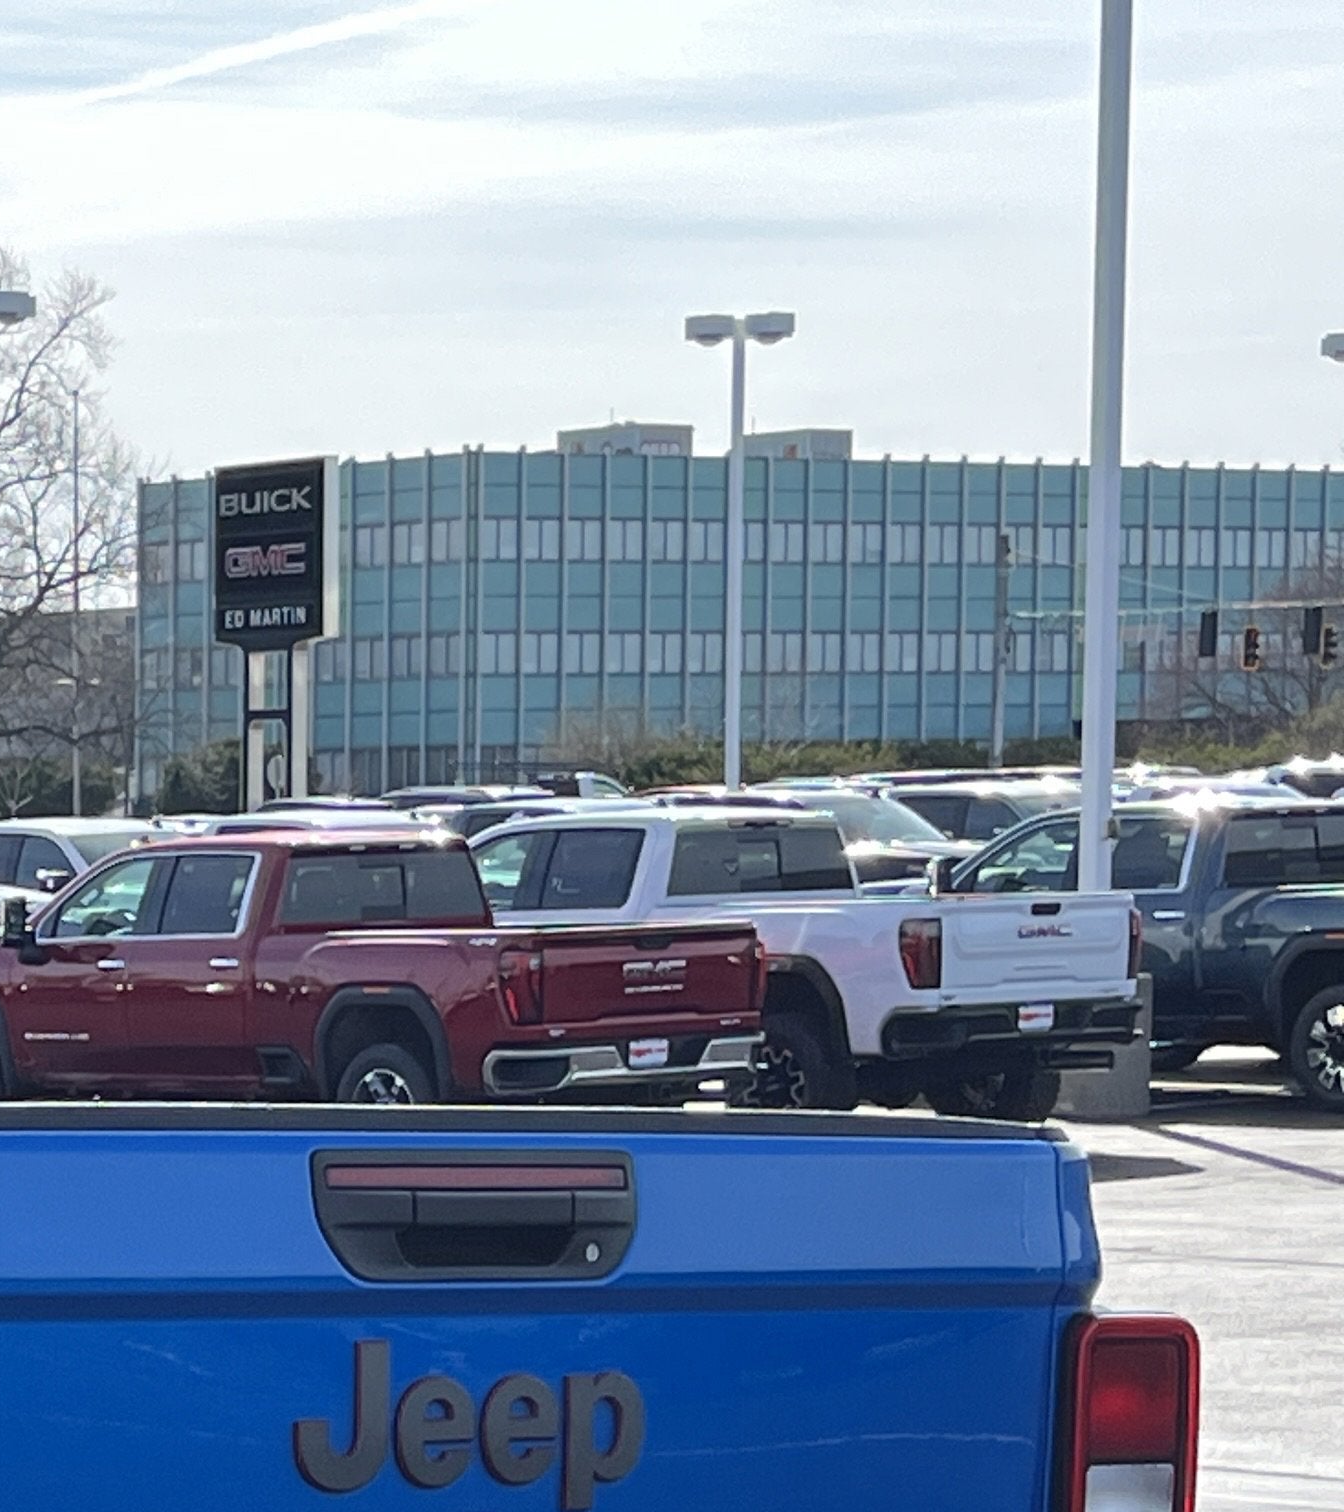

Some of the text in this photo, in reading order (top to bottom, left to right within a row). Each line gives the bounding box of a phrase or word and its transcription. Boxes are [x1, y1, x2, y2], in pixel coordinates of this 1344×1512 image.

[218, 485, 312, 517] BUICK
[224, 542, 307, 579] GMC
[224, 605, 307, 630] ED MARTIN
